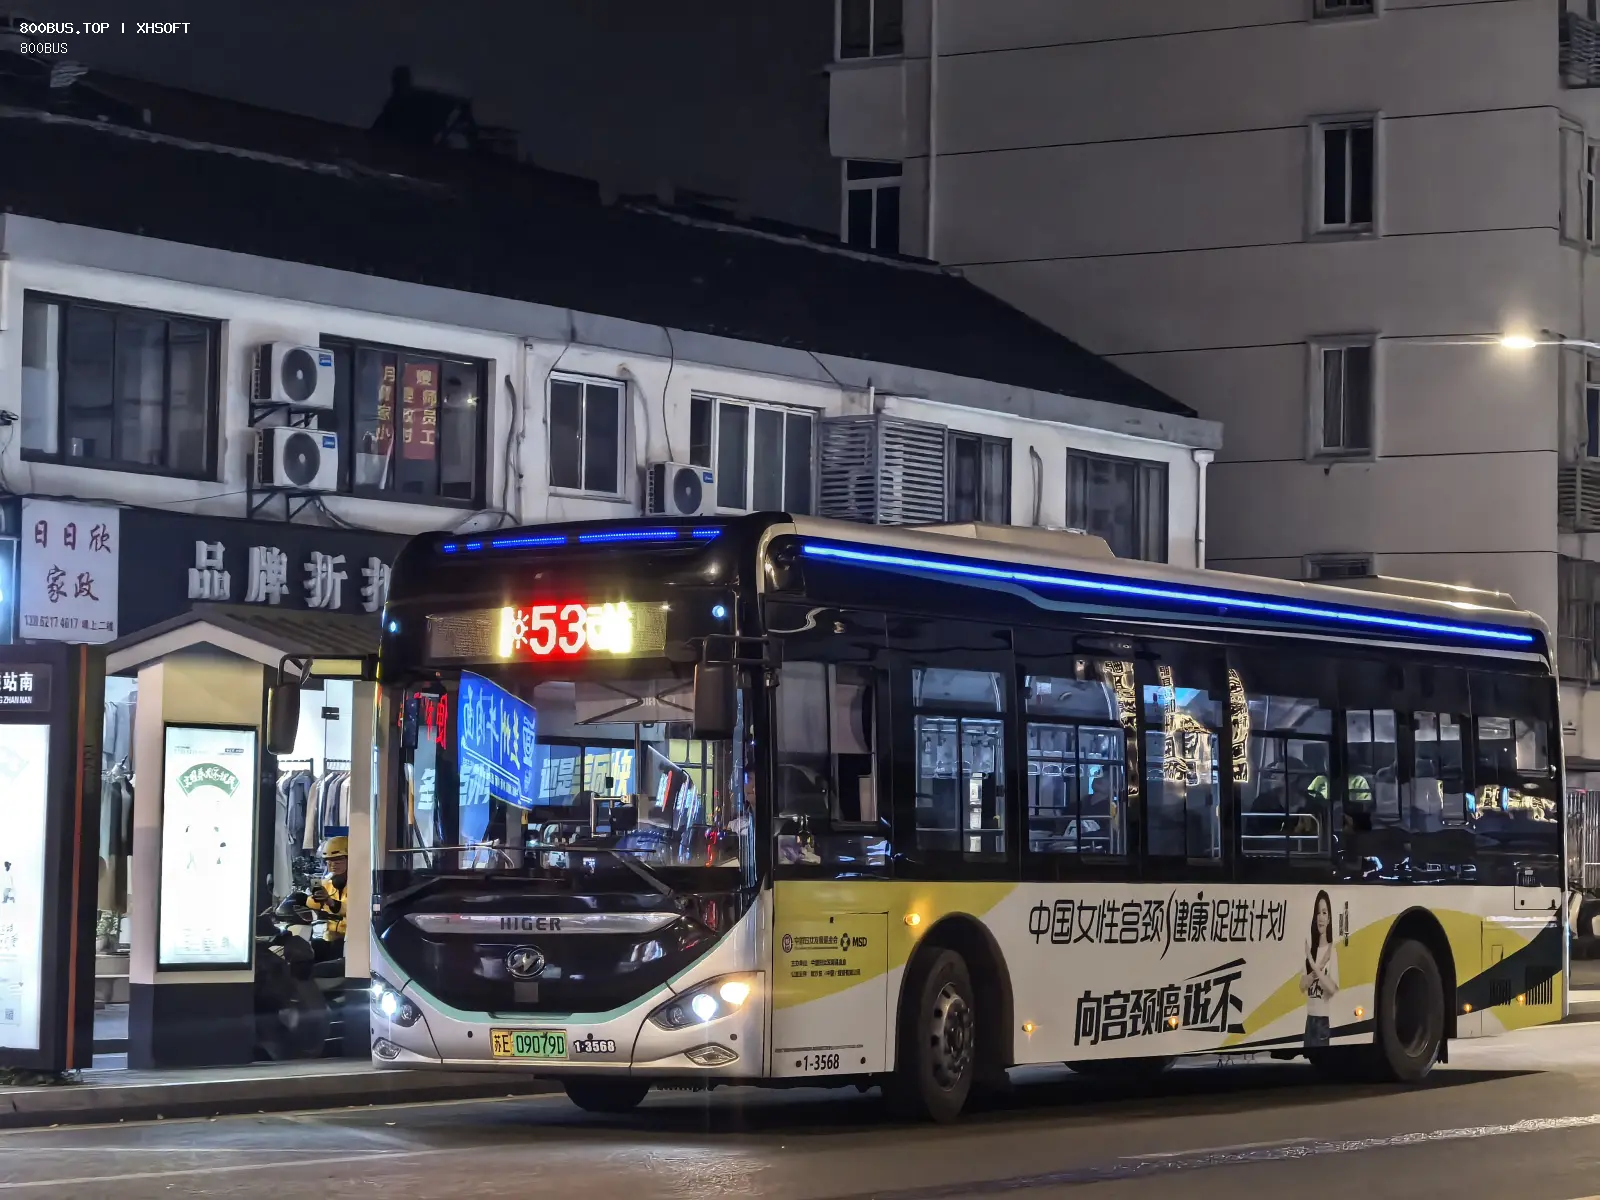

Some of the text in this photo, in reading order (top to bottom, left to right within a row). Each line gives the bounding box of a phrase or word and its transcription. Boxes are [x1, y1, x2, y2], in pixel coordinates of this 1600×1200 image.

[34, 519, 112, 554] 日日欣
[46, 564, 100, 604] 家政
[0, 671, 34, 692] 站南
[500, 917, 561, 931] HIGER
[1028, 890, 1288, 948] 中国女性宫颈健康促进计划
[852, 936, 868, 947] MSD
[1073, 968, 1245, 1046] 向宫颈癌说不
[803, 1053, 840, 1071] 1-3568
